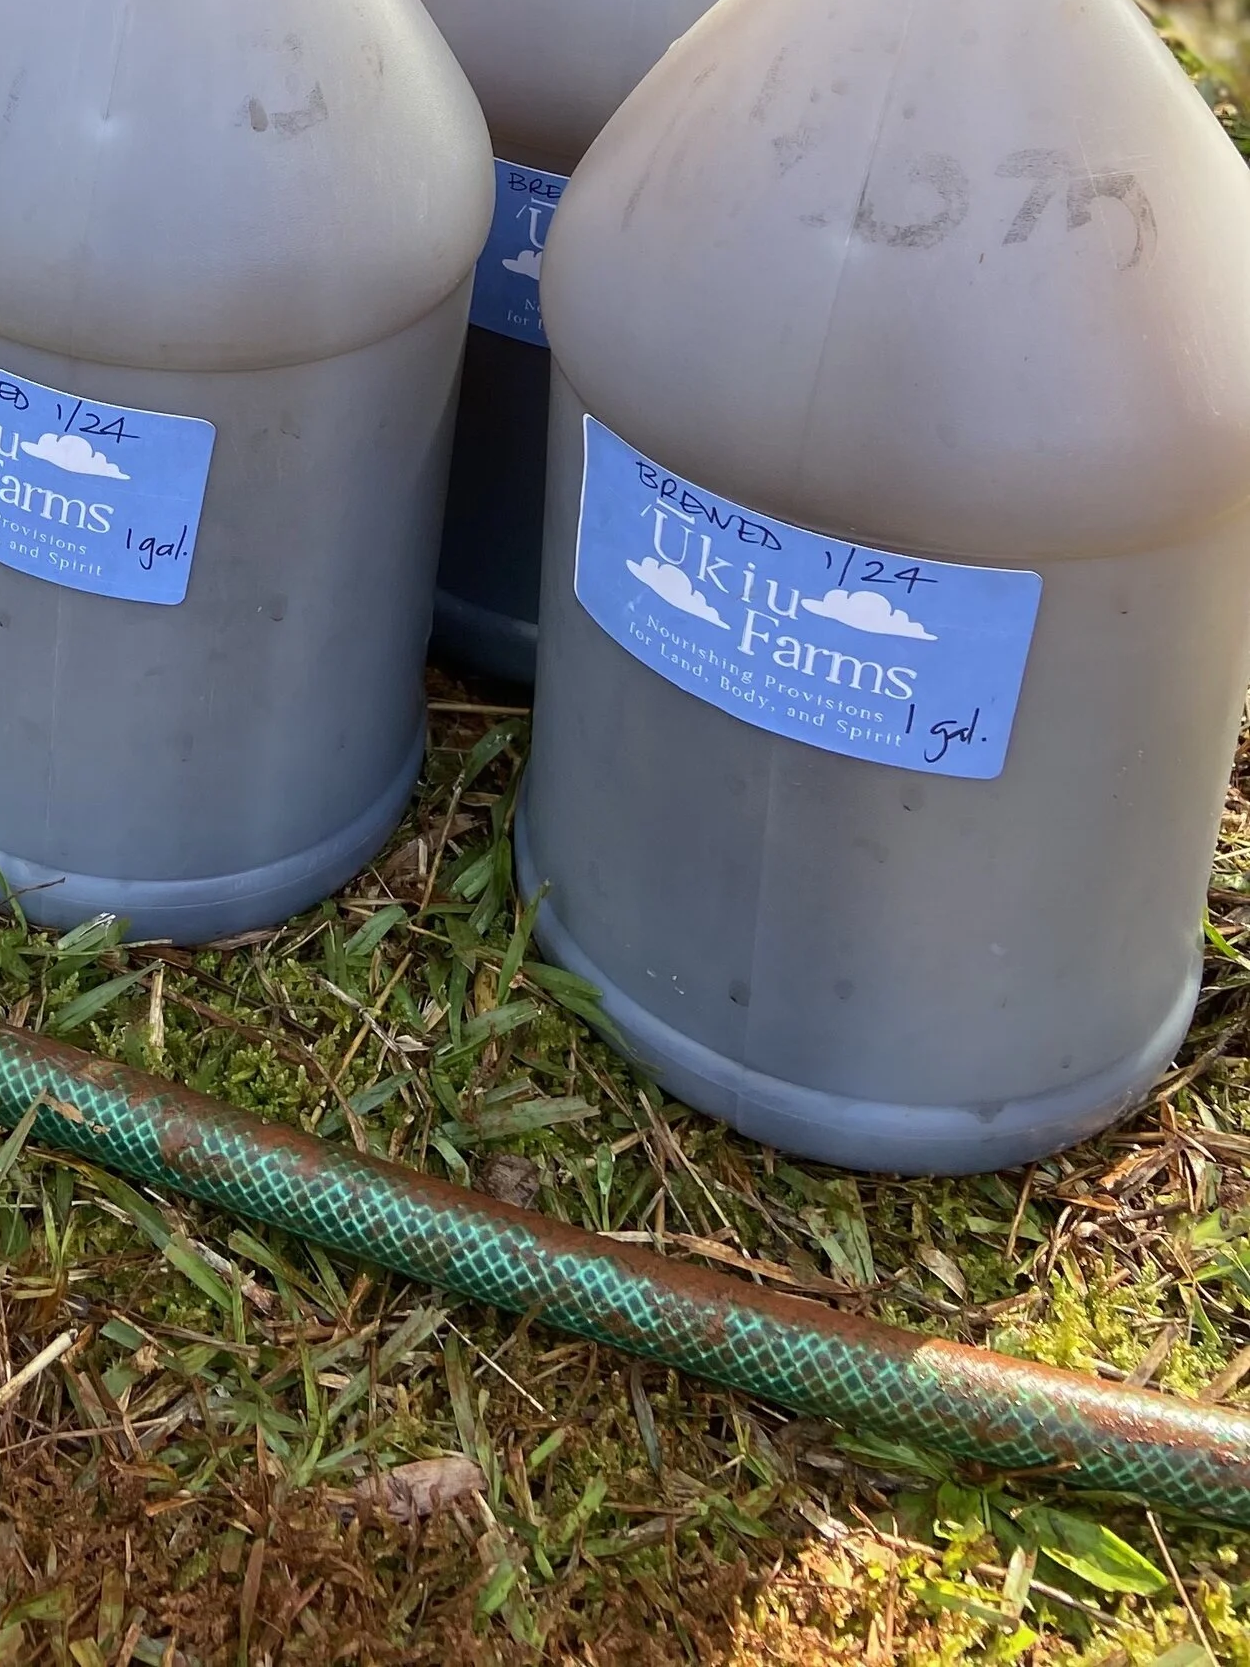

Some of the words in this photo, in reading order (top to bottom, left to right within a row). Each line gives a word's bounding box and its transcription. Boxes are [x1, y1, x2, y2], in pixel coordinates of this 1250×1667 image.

[508, 172, 561, 199] BRE
[56, 400, 140, 444] 1/24
[9, 540, 39, 559] and
[49, 552, 103, 576] Spirit
[636, 462, 782, 551] BREWED
[825, 547, 939, 594] 1/24
[629, 621, 652, 646] for
[660, 645, 710, 683] Land,
[720, 675, 776, 712] Body,
[787, 706, 826, 727] and
[836, 718, 902, 747] Spirit
[646, 614, 754, 684] Nourishing
[765, 674, 885, 723] Provisions
[736, 607, 918, 700] Farms
